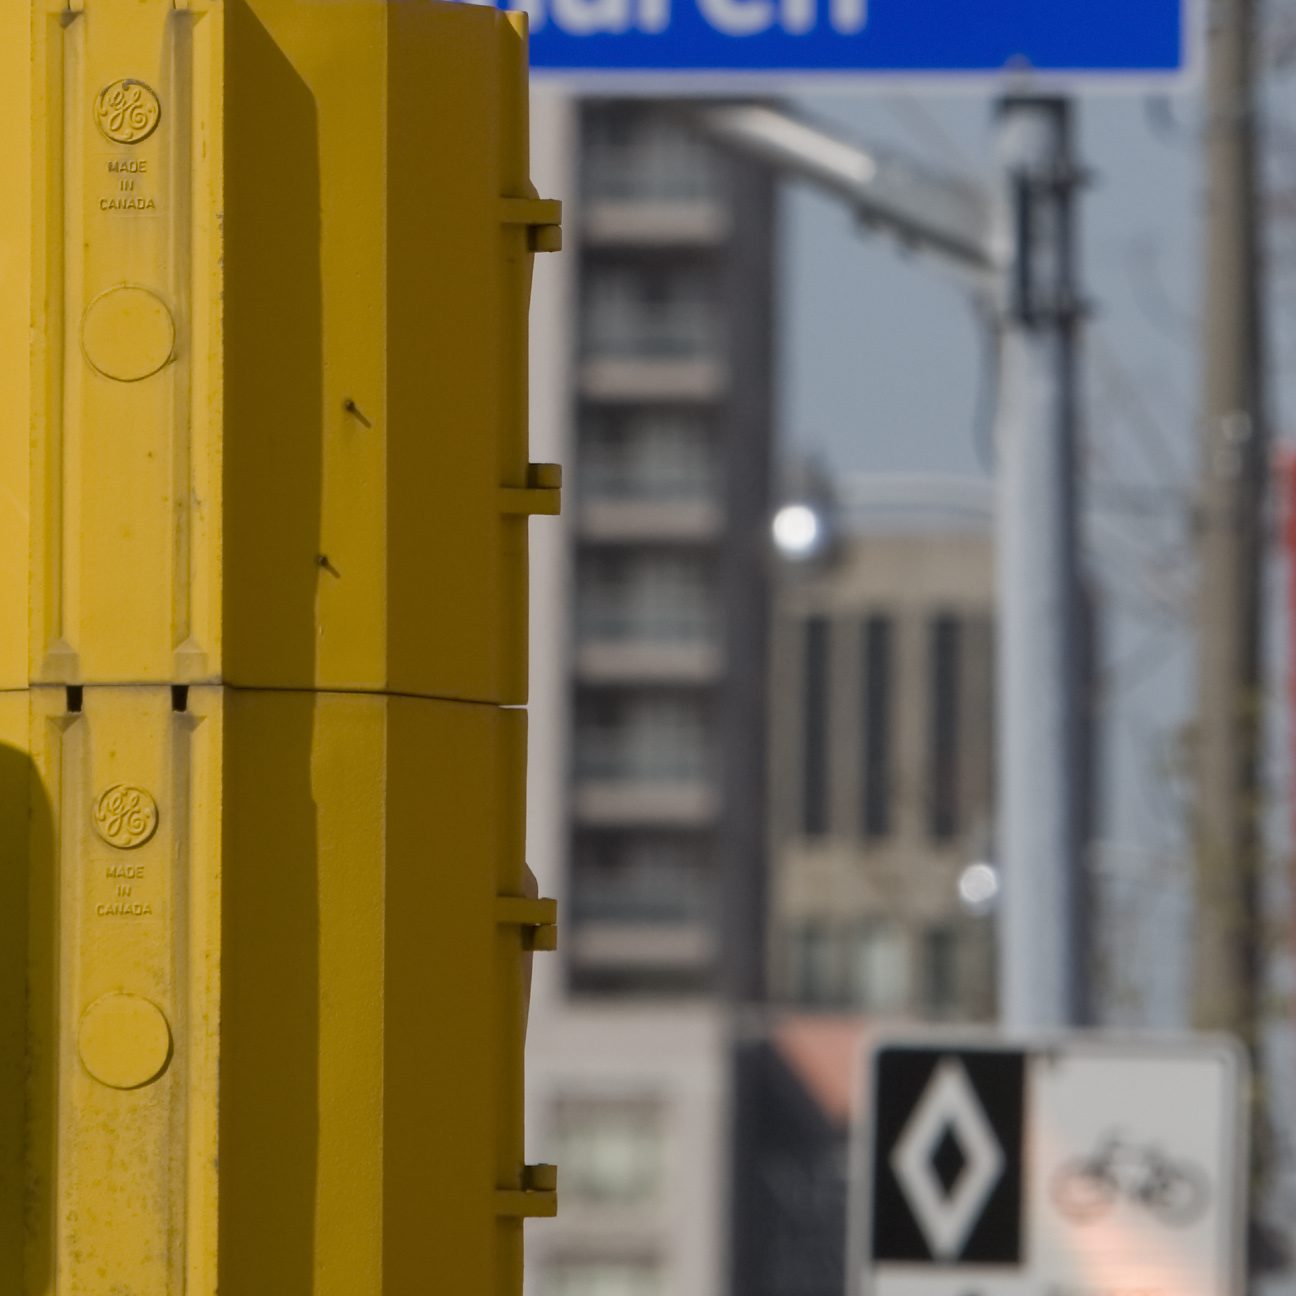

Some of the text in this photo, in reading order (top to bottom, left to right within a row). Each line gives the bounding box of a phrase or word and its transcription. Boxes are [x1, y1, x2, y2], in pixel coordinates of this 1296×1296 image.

[107, 160, 147, 174] MADE
[119, 180, 134, 191] IN
[99, 198, 156, 211] CANADA
[105, 865, 145, 880] MADE
[117, 885, 132, 897] IN
[96, 904, 153, 917] CANADA
